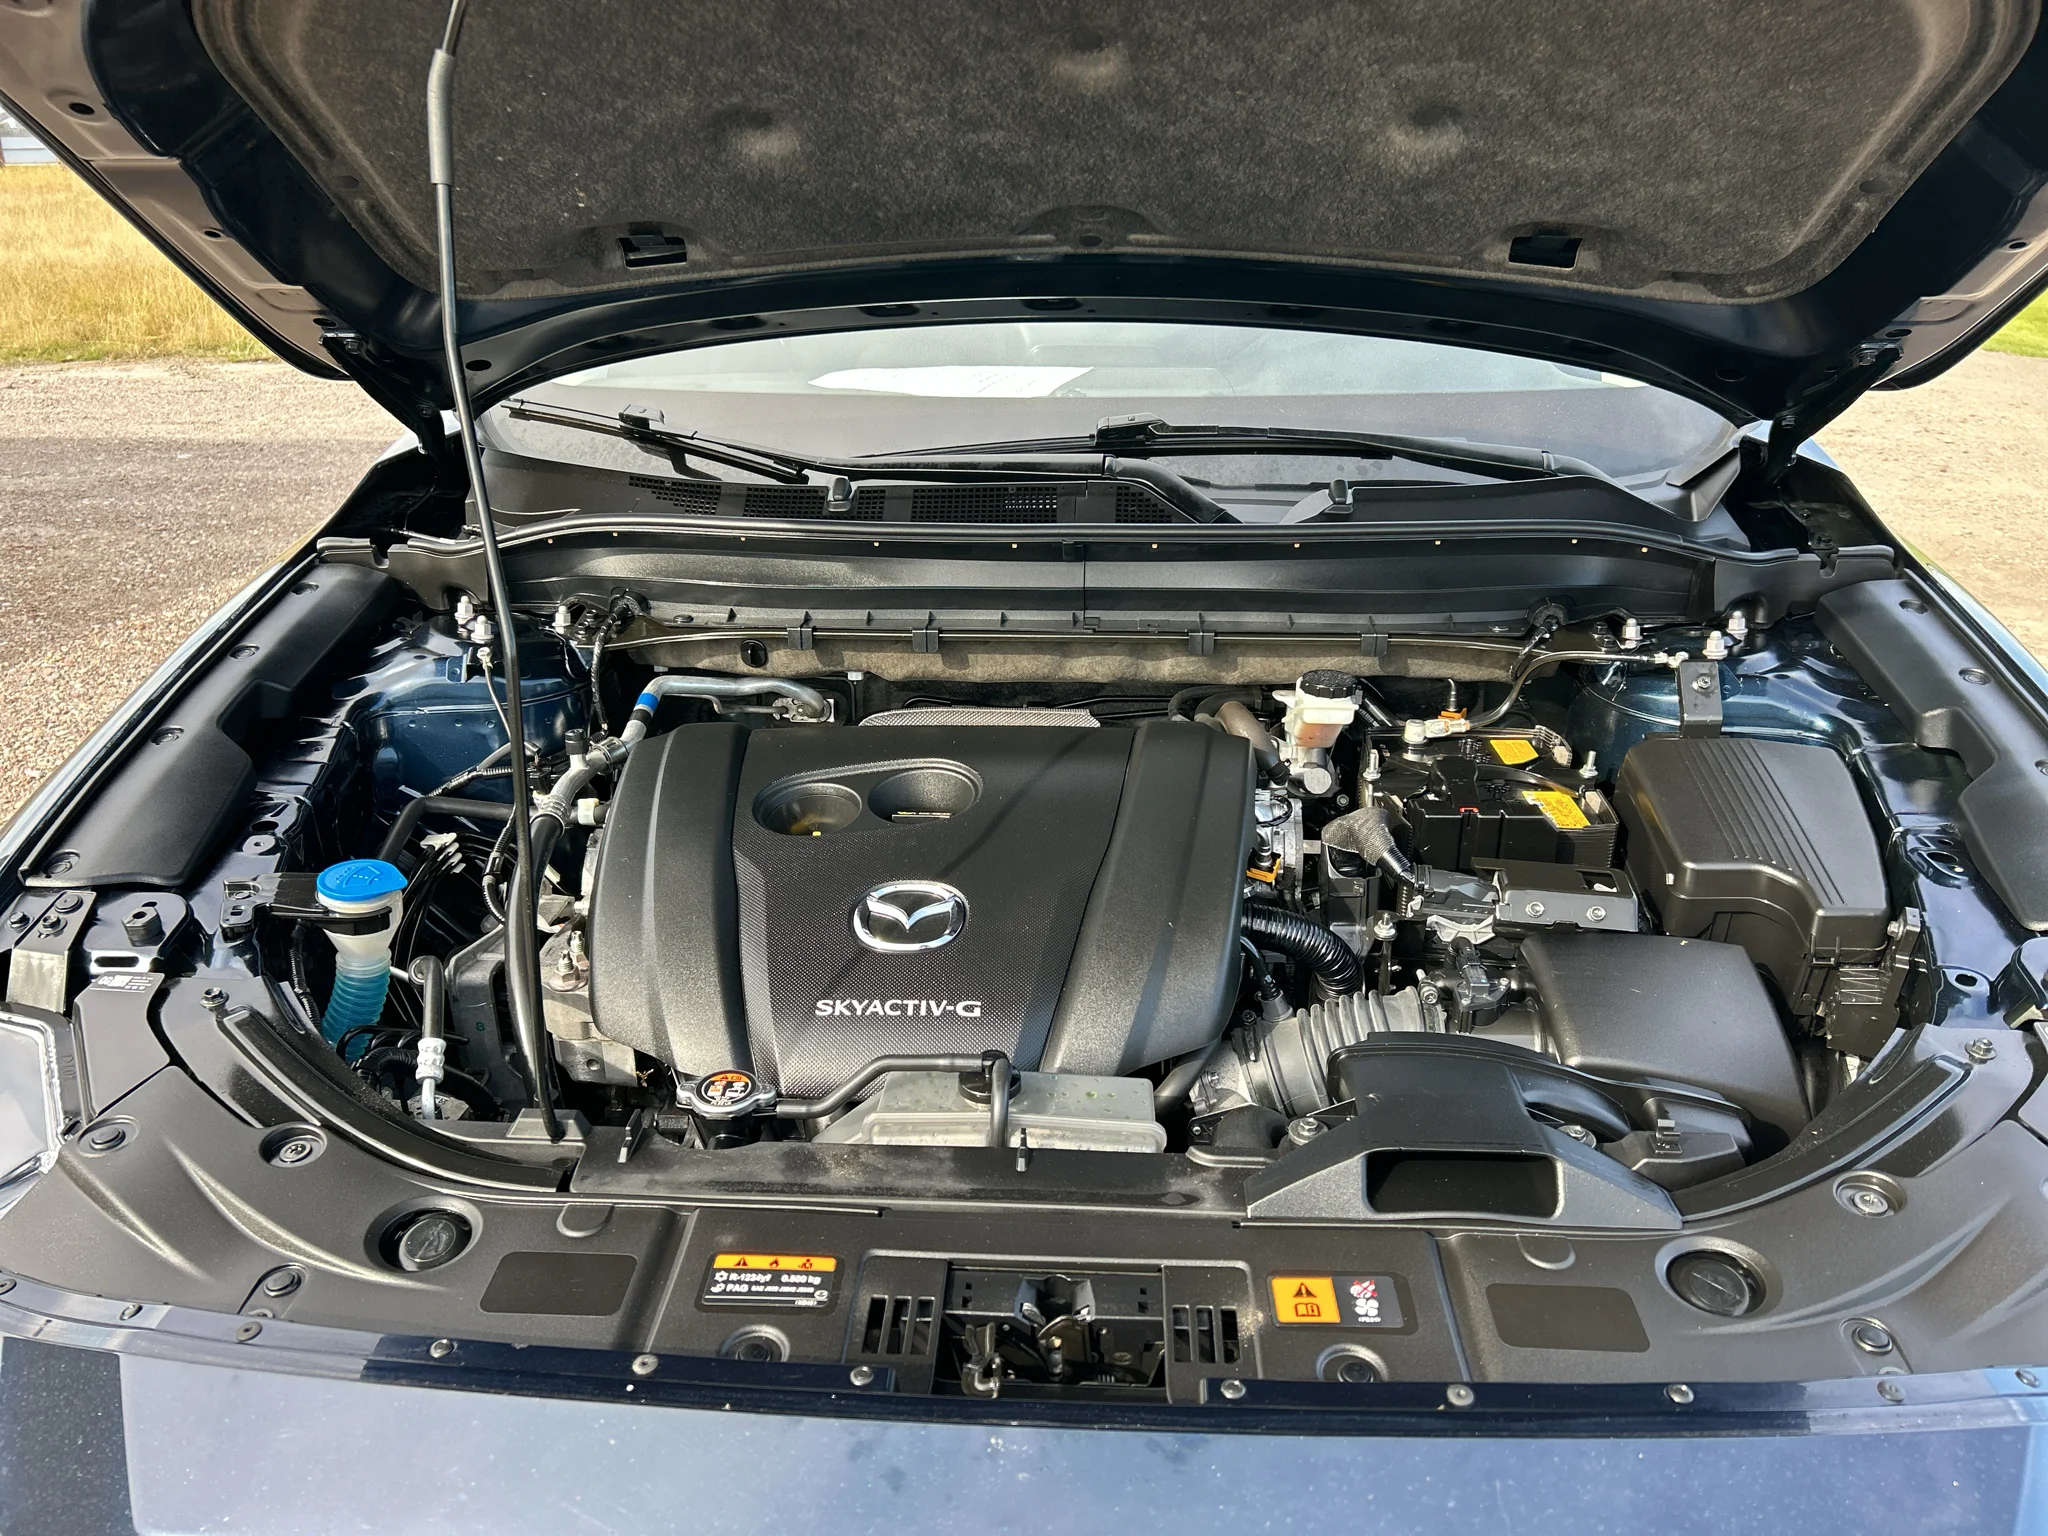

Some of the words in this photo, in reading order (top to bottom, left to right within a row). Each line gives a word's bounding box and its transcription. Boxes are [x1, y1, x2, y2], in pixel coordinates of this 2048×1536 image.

[815, 1000, 982, 1017] SKYACTIV-G
[808, 1275, 821, 1285] kg
[726, 1283, 749, 1292] PAG
